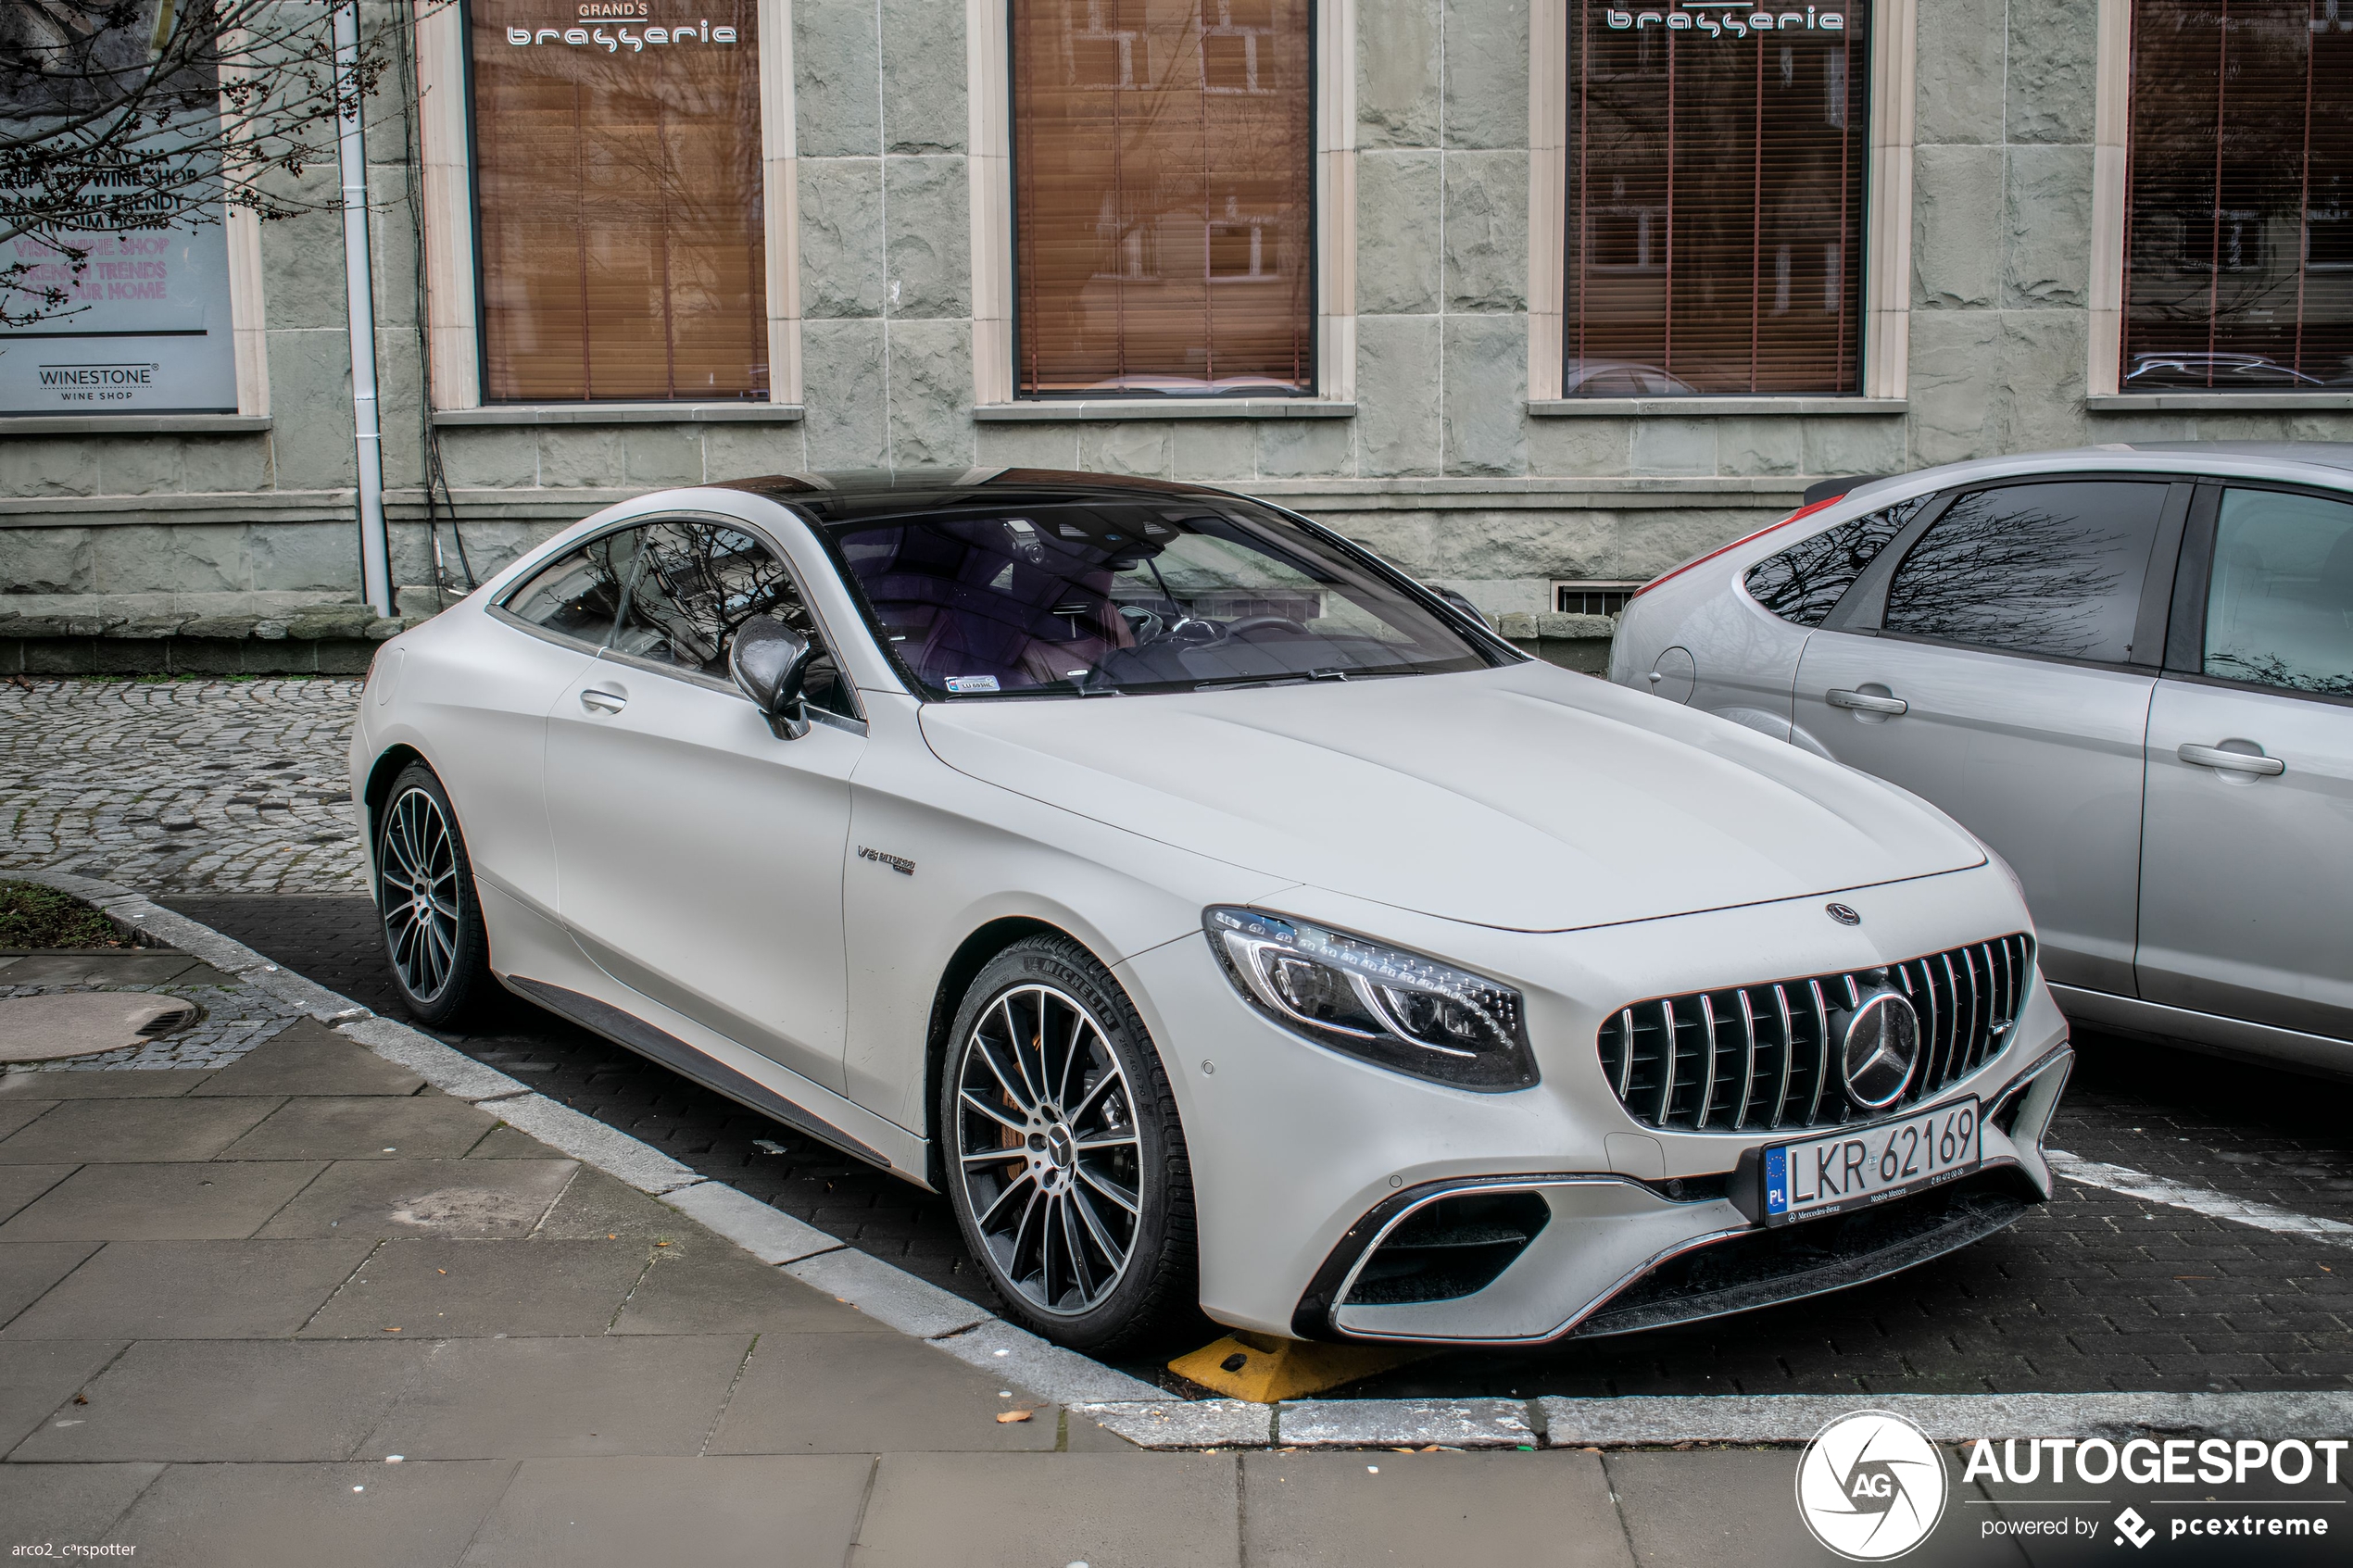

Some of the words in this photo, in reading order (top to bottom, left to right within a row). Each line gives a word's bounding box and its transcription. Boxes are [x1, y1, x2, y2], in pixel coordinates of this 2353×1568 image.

[579, 1, 648, 16] GRAND'S
[1607, 5, 1843, 38] brasserie
[507, 19, 737, 53] brasserie
[120, 237, 170, 256] SHOP
[96, 261, 168, 280] TRENDS
[107, 281, 167, 300] HOME
[39, 370, 151, 384] WINESTONE
[99, 392, 133, 400] SHOP
[1041, 961, 1116, 1027] MICHELIN
[1791, 1137, 1865, 1204] LKR
[1879, 1108, 1973, 1182] 62169
[1769, 1189, 1785, 1205] PL
